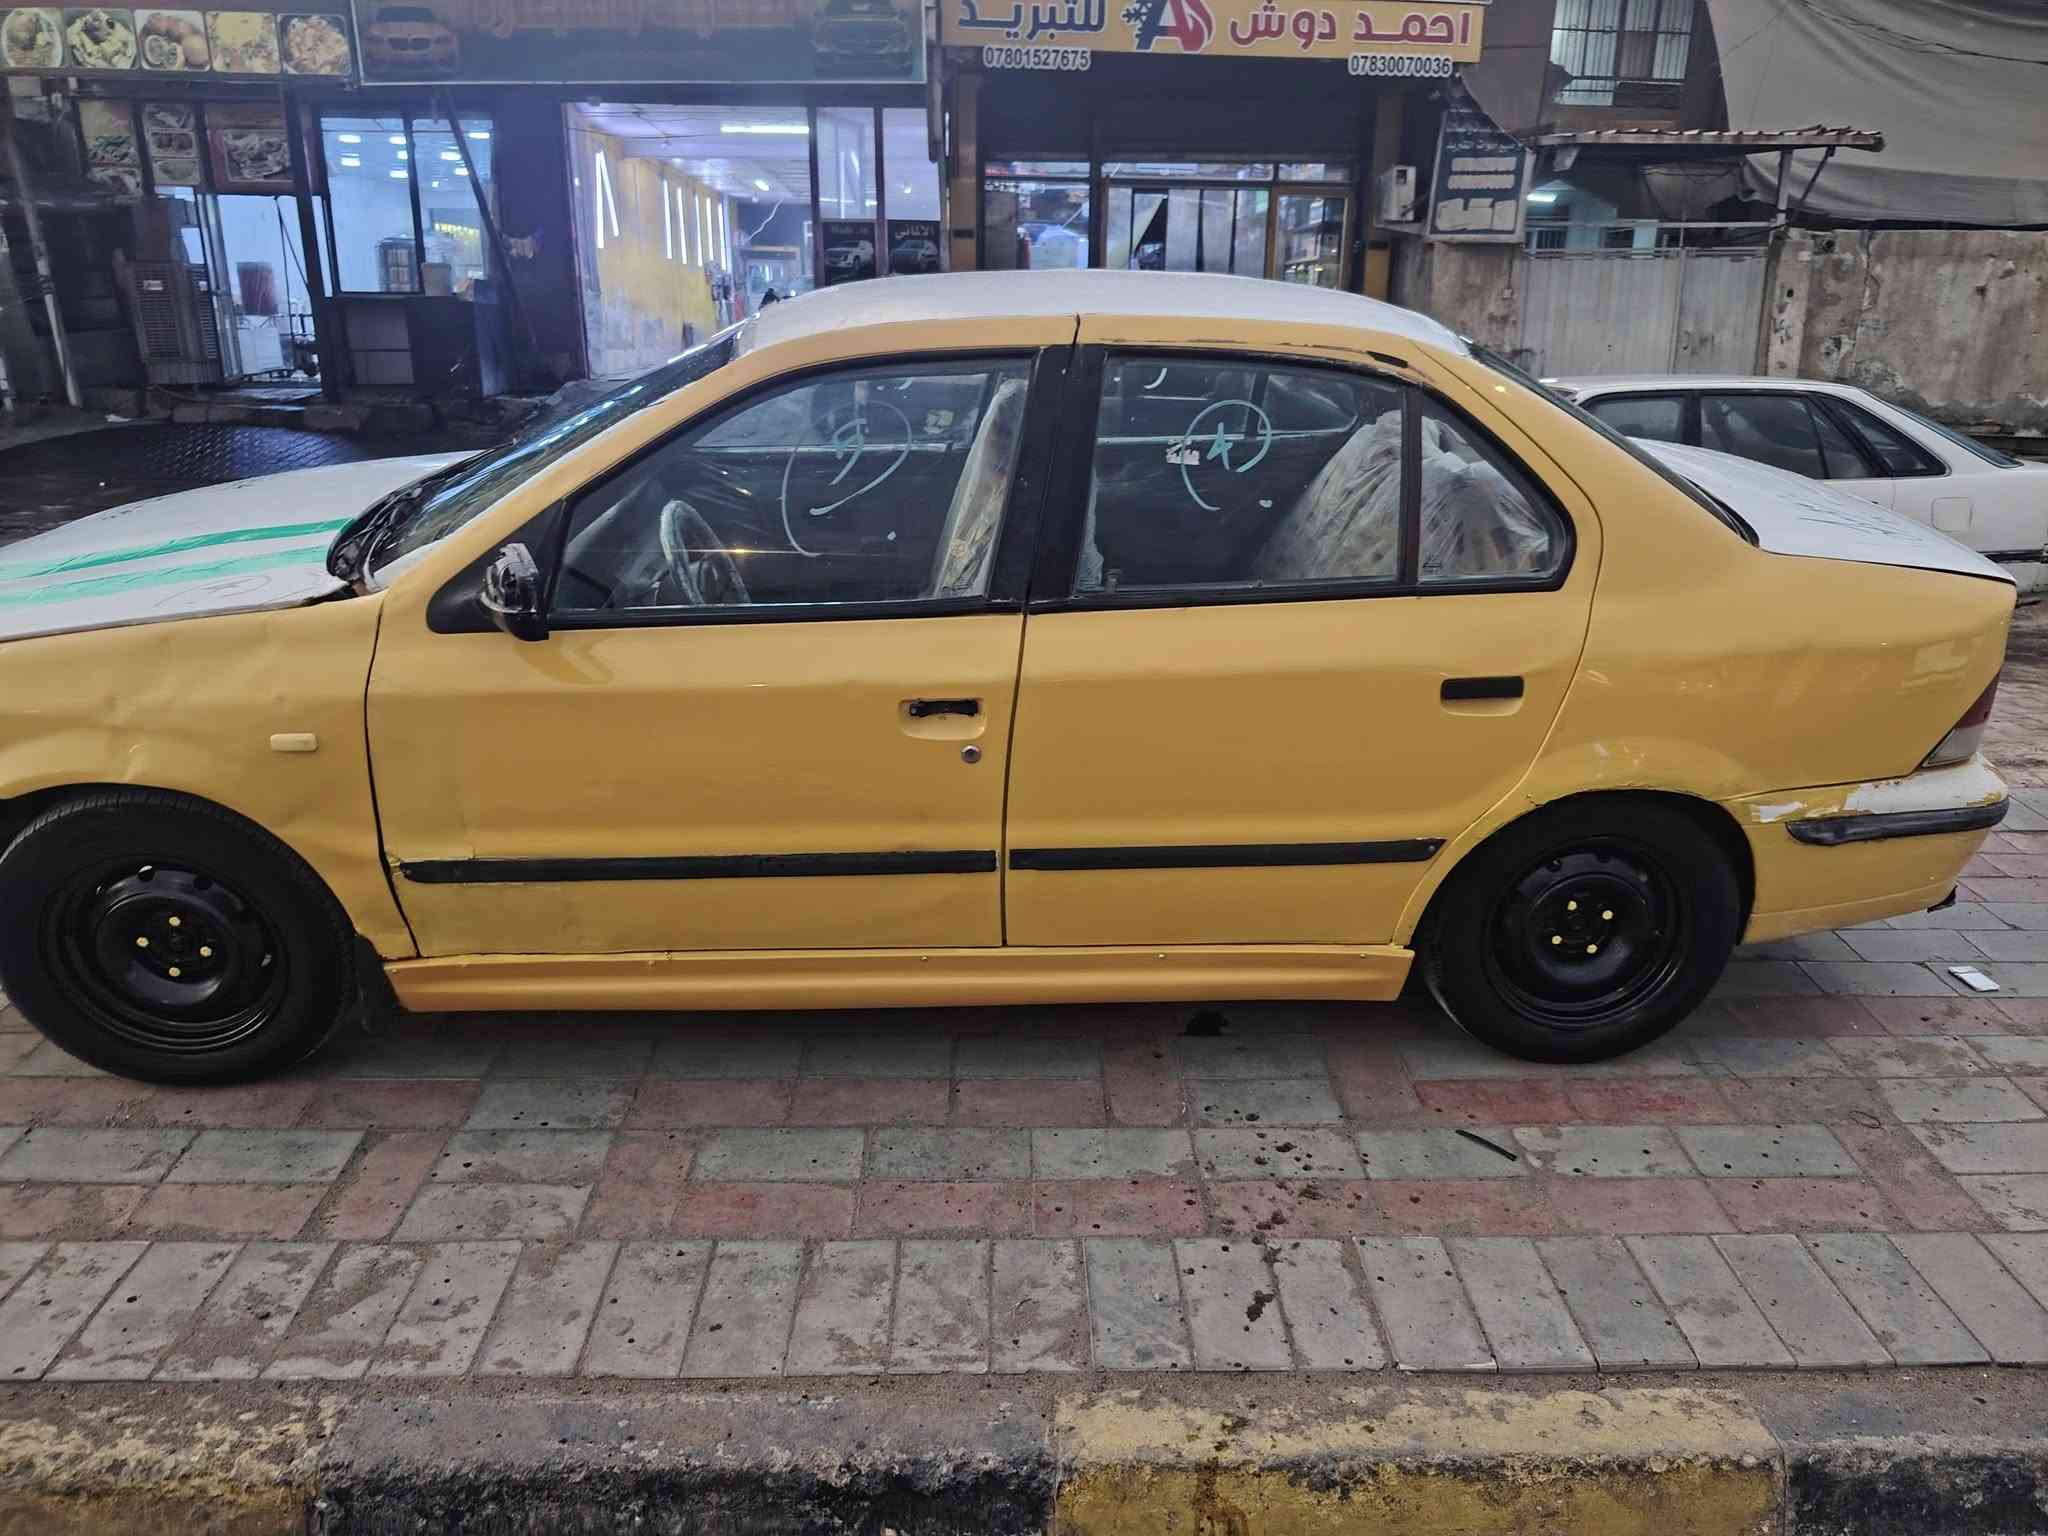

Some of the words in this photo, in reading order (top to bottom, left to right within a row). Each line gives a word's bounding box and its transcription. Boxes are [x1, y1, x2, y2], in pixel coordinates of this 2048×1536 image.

[1352, 11, 1471, 45] احمد
[984, 47, 1091, 70] 07801527675
[1350, 55, 1451, 76] 07830070036
